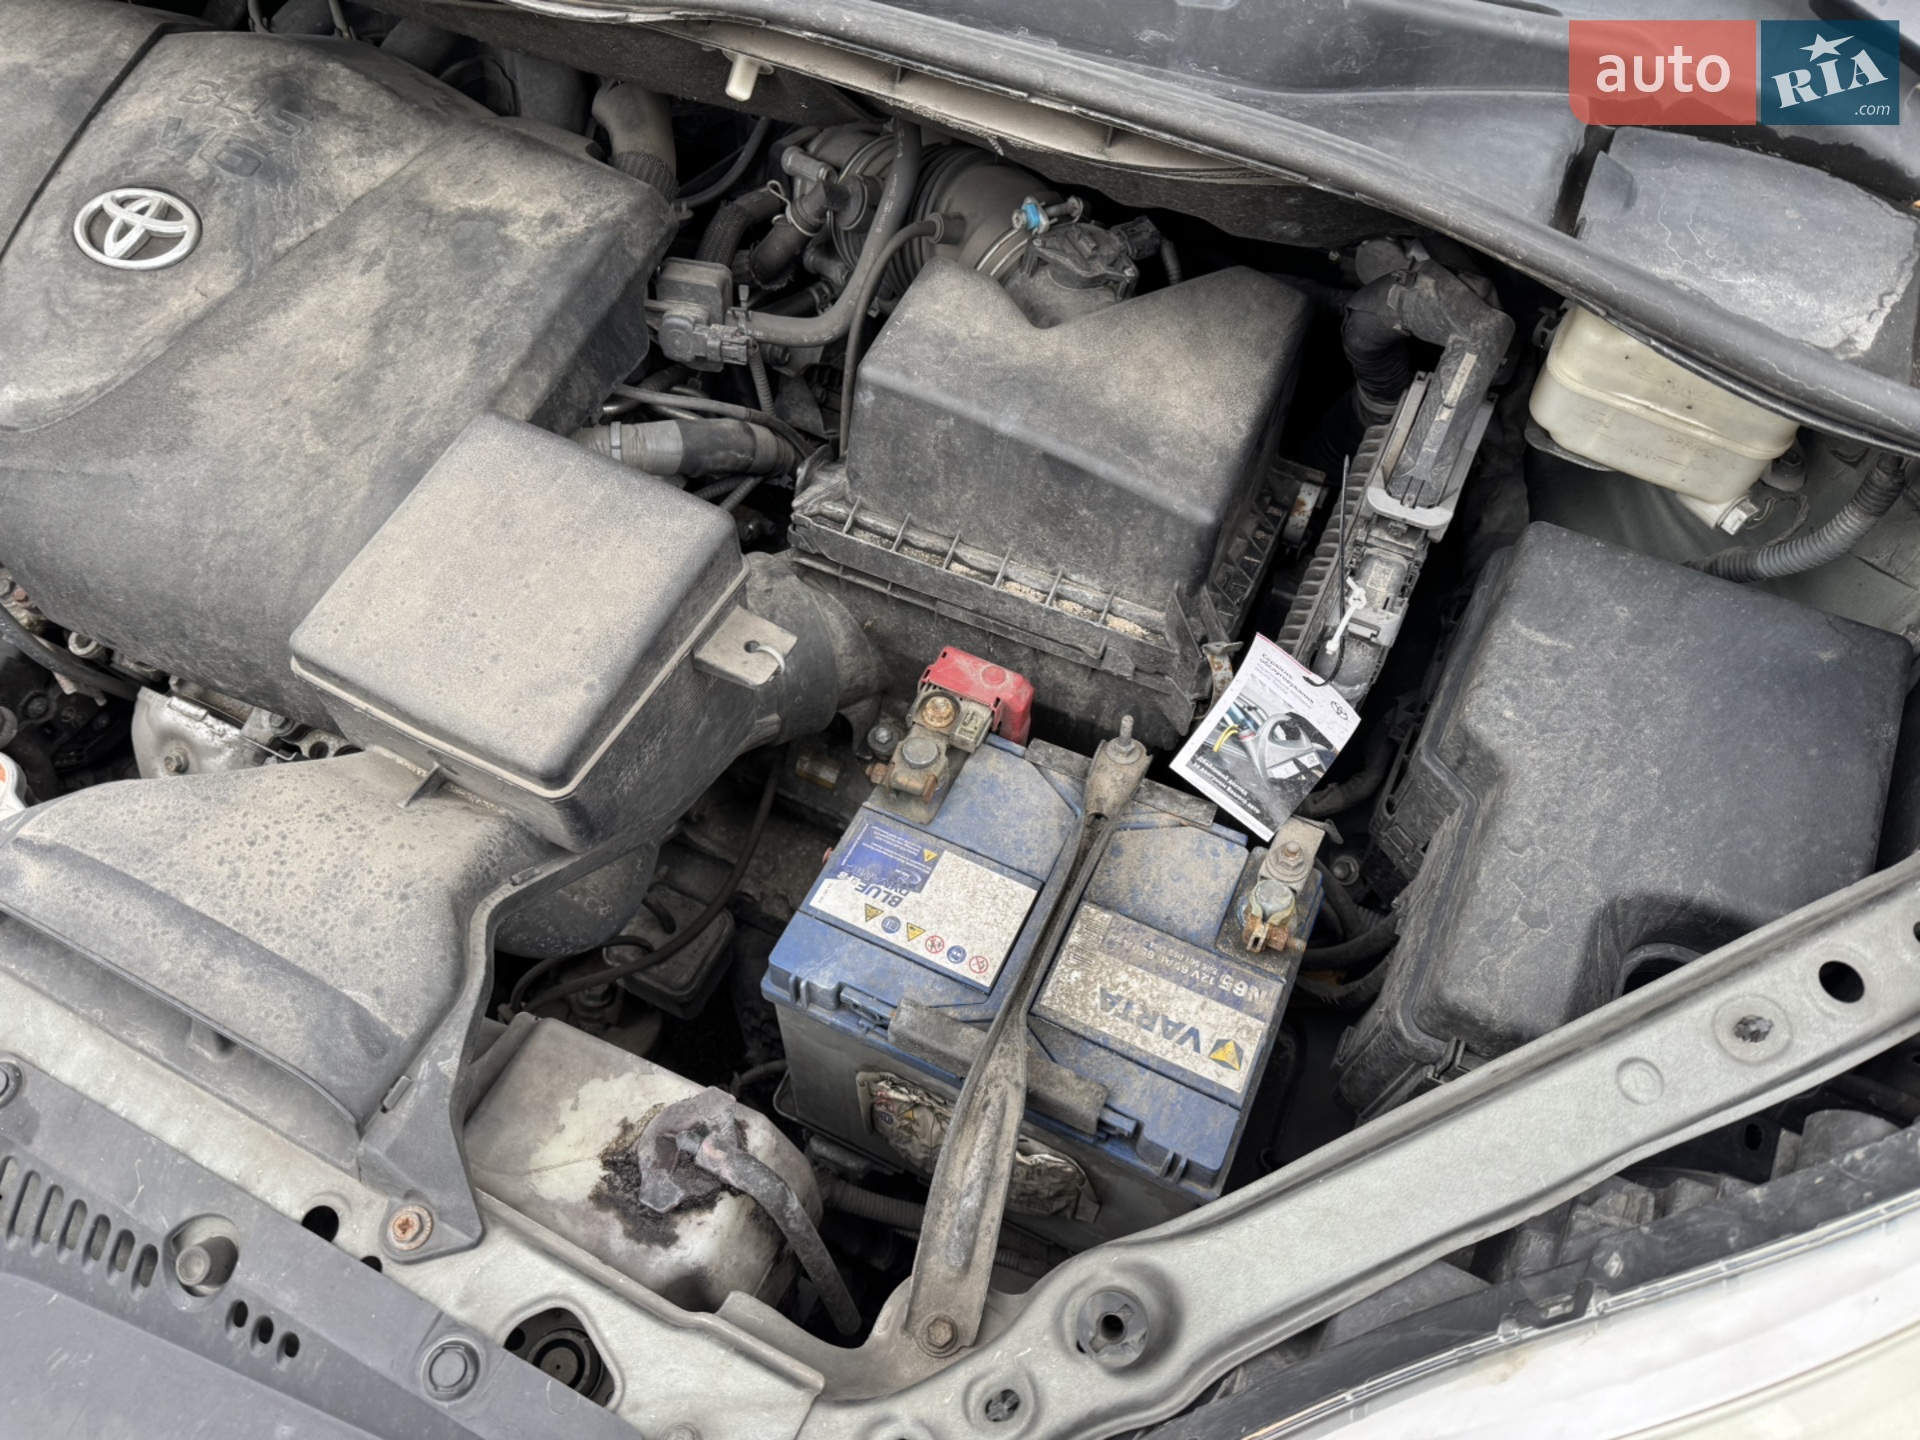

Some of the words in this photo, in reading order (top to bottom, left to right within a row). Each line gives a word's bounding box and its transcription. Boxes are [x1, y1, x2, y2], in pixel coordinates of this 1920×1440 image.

[855, 883, 903, 908] BLUE
[1190, 969, 1216, 986] 12V
[1218, 972, 1267, 1003] N65
[1098, 987, 1201, 1053] VARTA
